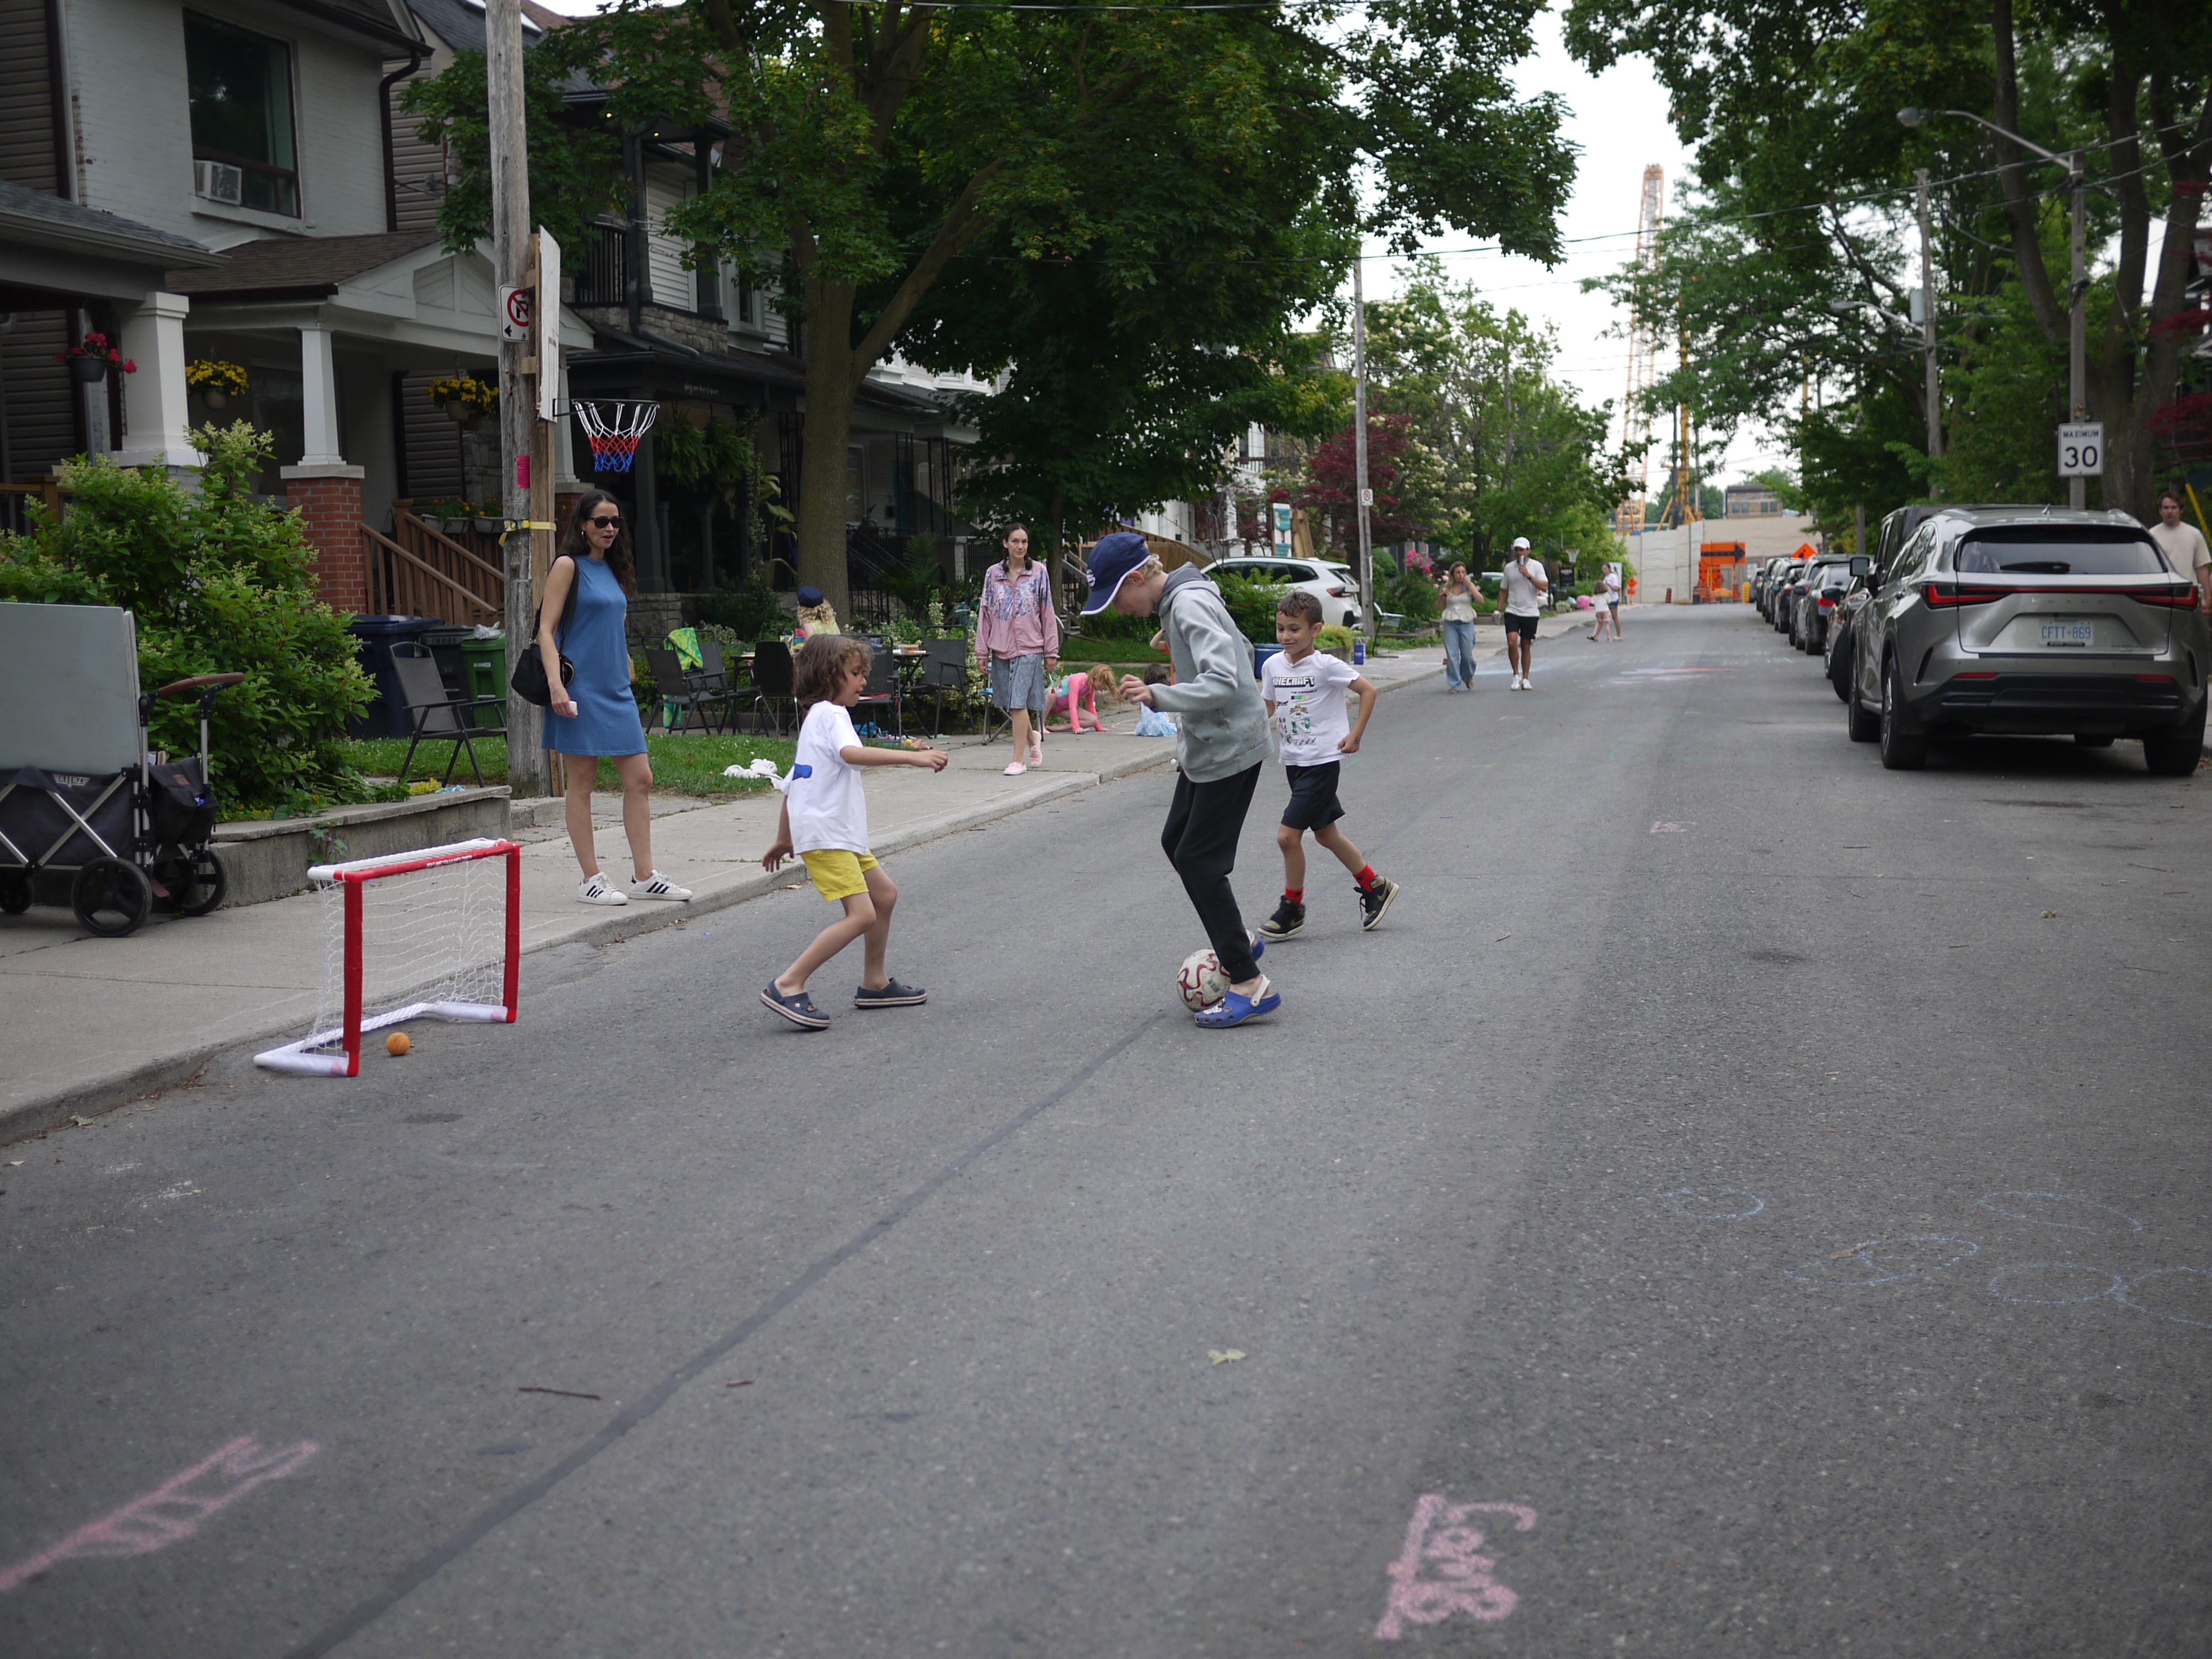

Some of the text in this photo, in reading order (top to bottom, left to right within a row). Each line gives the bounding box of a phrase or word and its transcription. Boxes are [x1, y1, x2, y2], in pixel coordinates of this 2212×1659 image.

[2063, 429, 2099, 438] MAXIMUM
[2064, 445, 2098, 468] 30
[2072, 626, 2091, 639] 869
[59, 775, 82, 784] KEENZ
